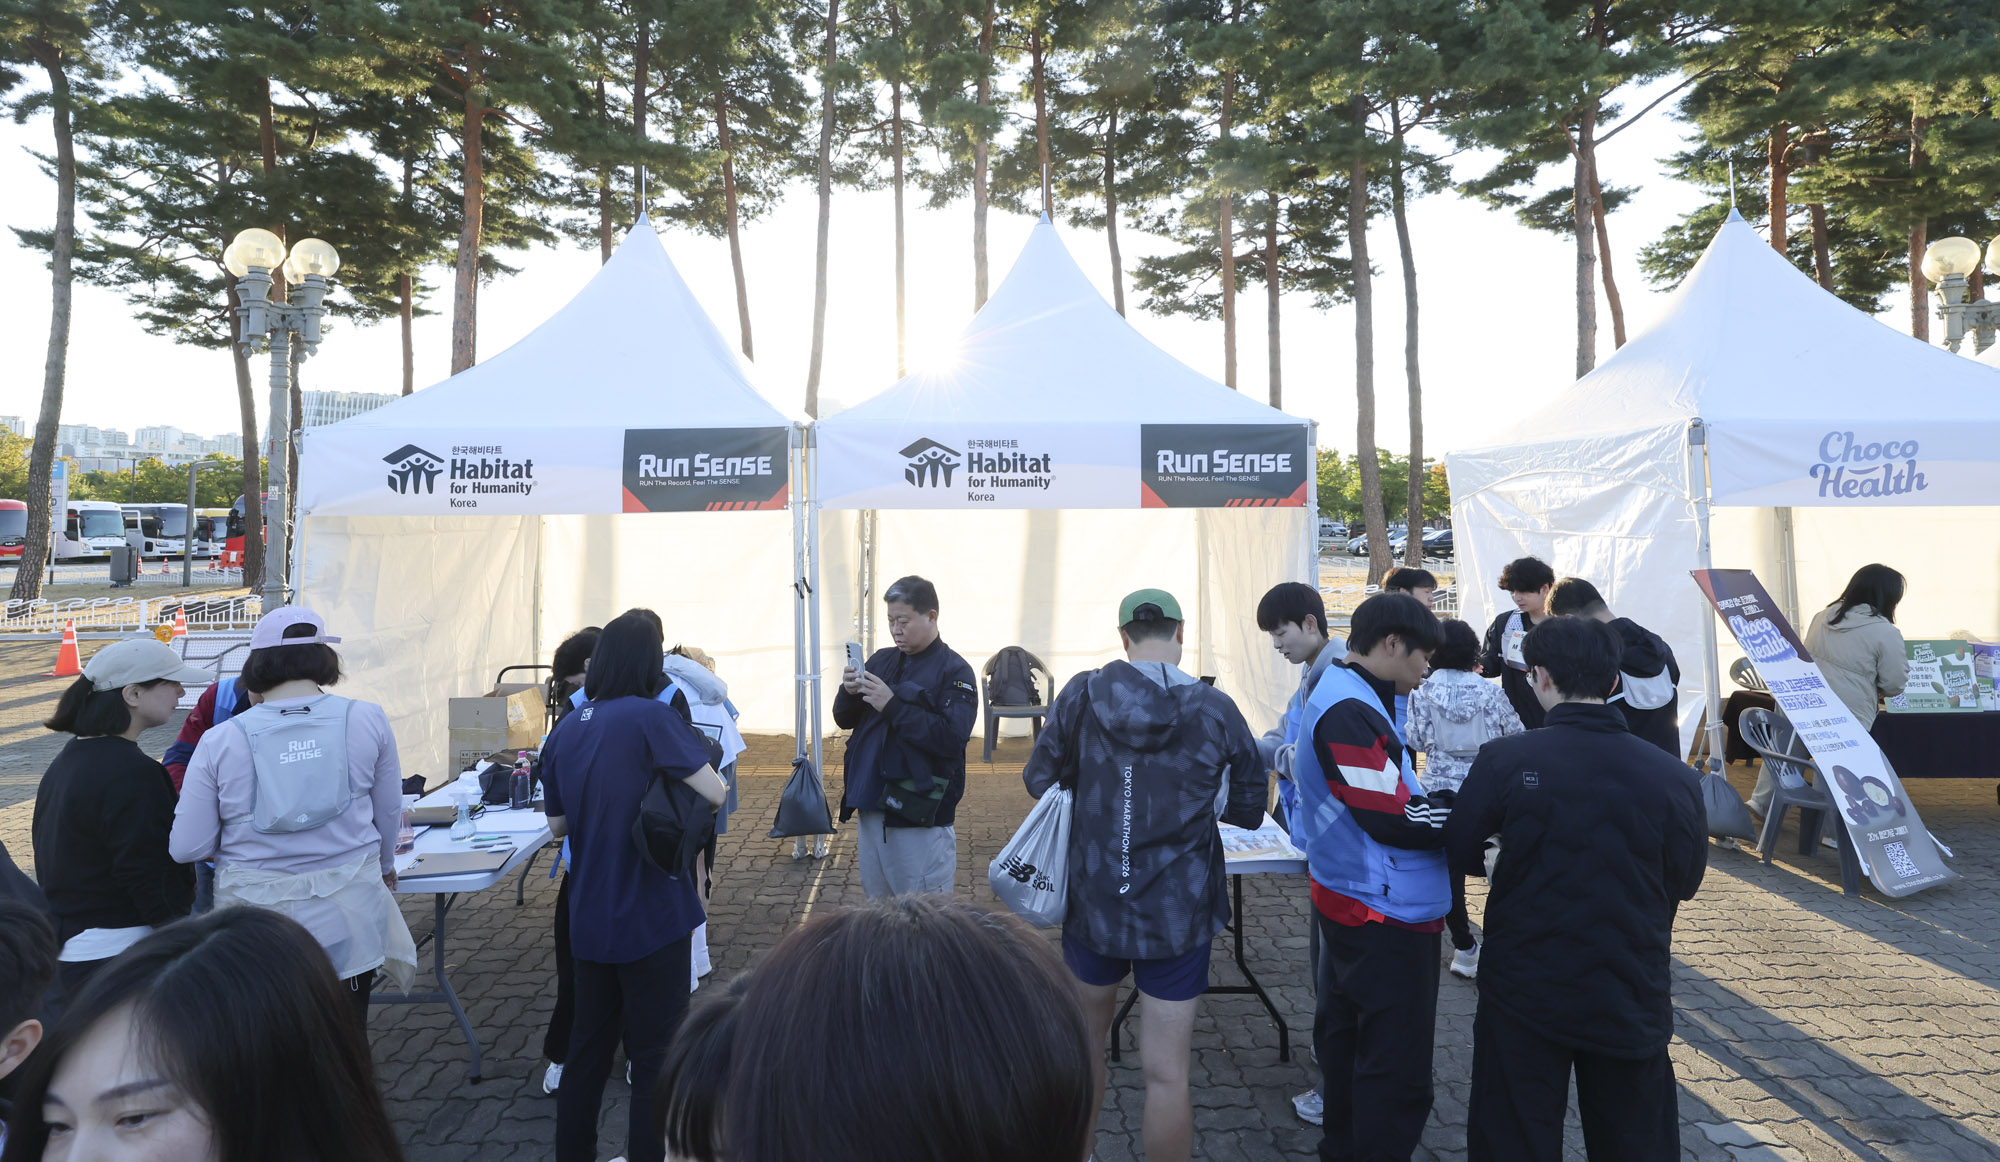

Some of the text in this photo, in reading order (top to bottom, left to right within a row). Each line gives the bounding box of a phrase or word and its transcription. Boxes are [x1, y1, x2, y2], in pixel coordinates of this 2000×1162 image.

[452, 446, 503, 455] 한국해비타트
[967, 439, 1019, 449] 한국해비타트
[1818, 431, 1920, 464] Choco
[450, 458, 534, 480] Habitat
[968, 452, 1051, 474] Habitat
[449, 481, 470, 493] for
[719, 478, 740, 486] SENSE
[967, 476, 986, 487] for
[1808, 459, 1929, 498] Health
[450, 498, 477, 508] Korea
[968, 492, 995, 502] Korea
[1729, 616, 1773, 639] Choco
[1738, 631, 1792, 661] Health
[1122, 765, 1133, 878] TOKYO MARATHON 2026
